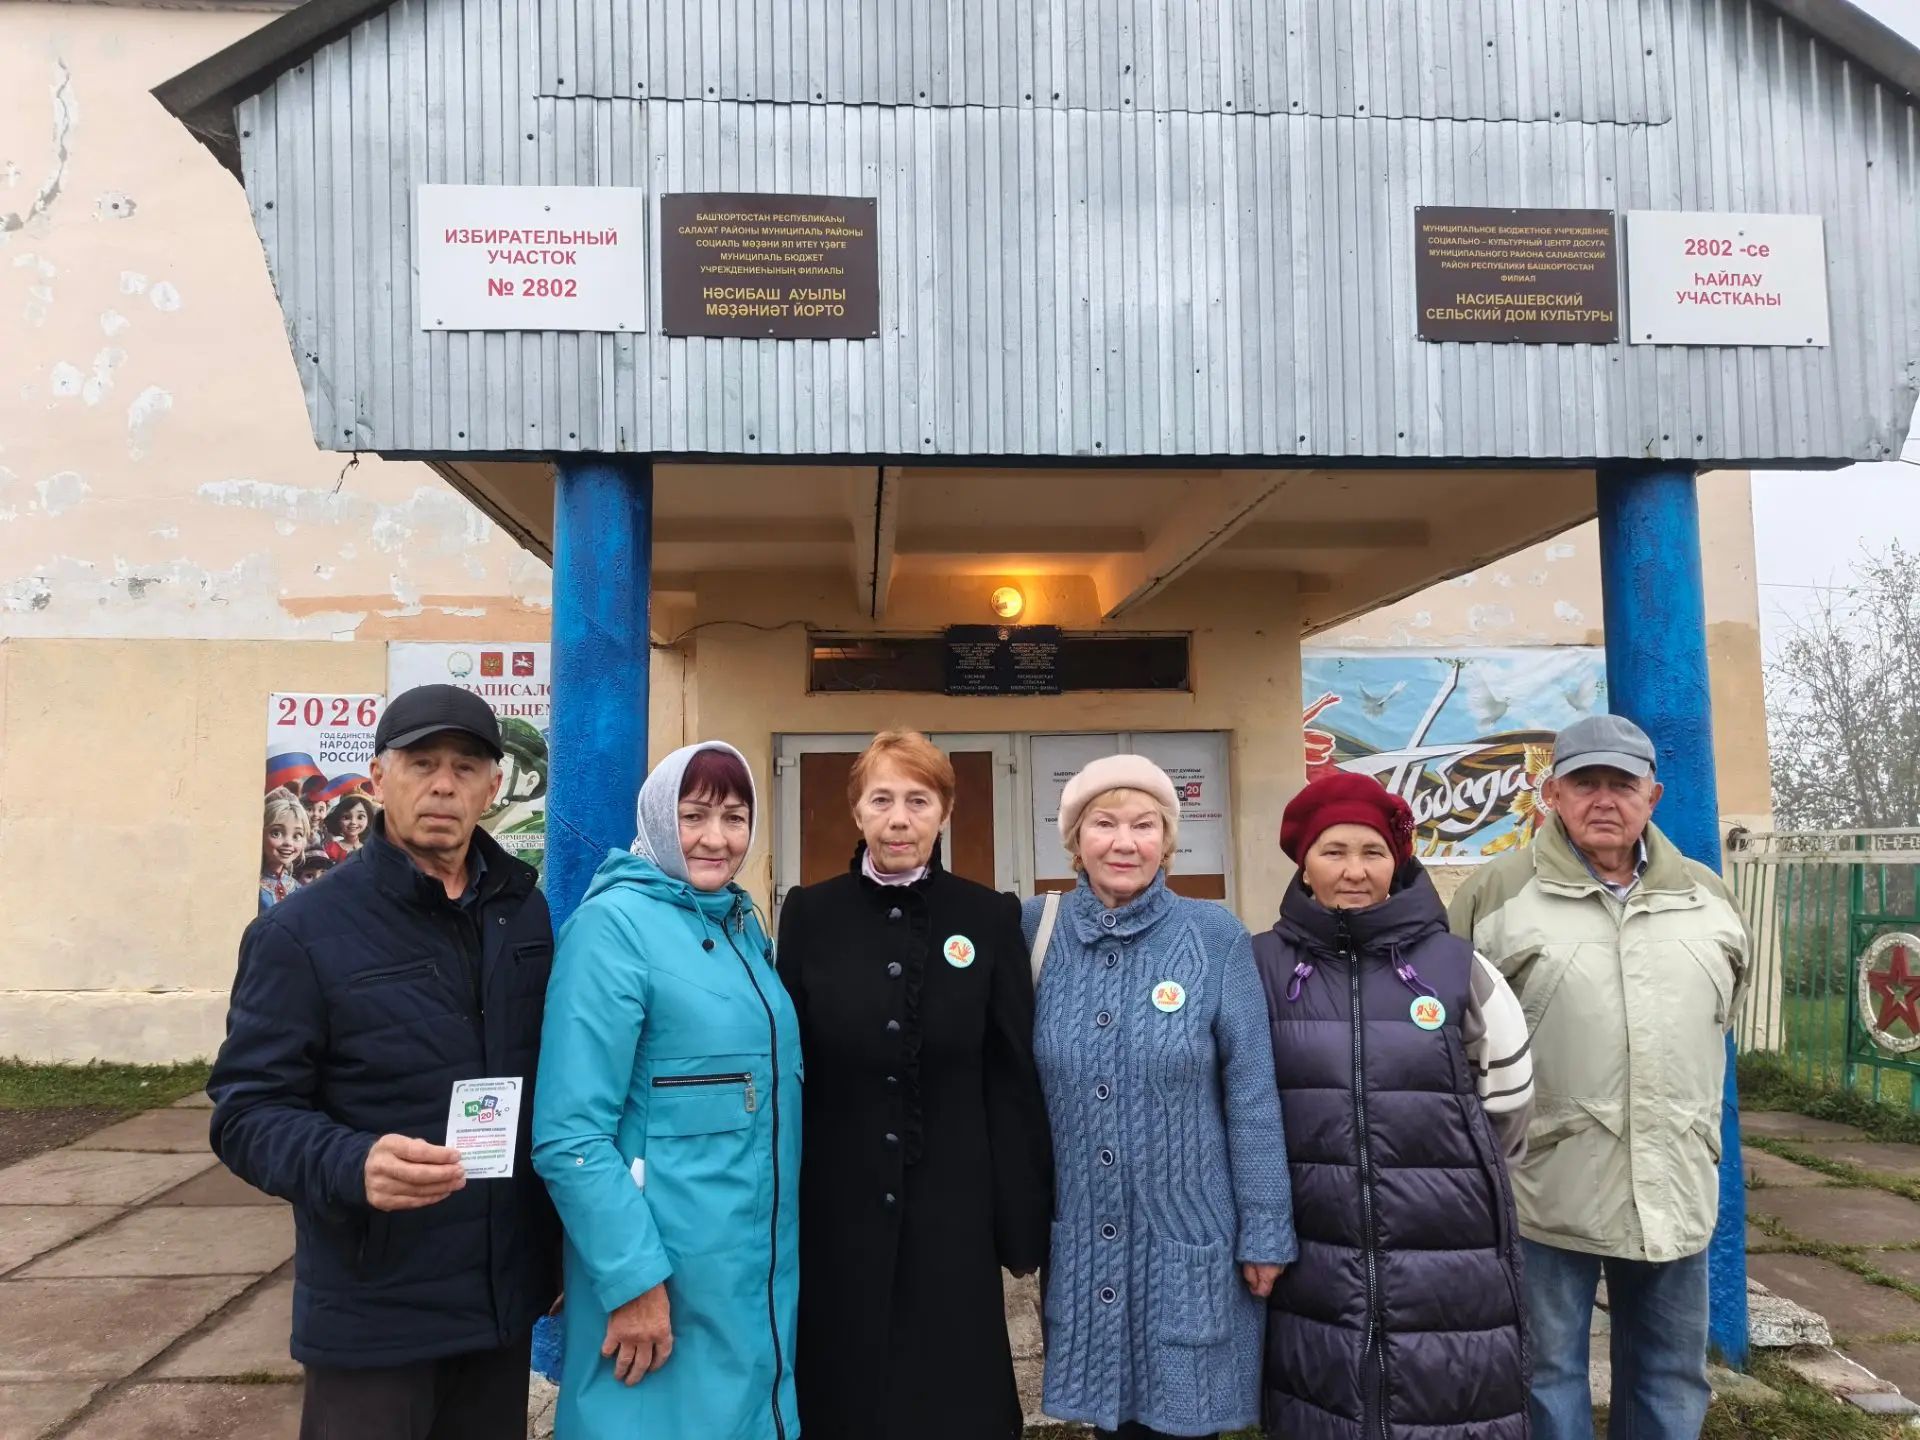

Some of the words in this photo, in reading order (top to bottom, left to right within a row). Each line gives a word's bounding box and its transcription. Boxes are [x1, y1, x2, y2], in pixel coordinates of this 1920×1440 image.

[721, 226, 759, 234] РАЙОНЫ
[762, 228, 822, 236] МУНИЦИПАЛЬ
[1423, 225, 1496, 234] МУНИЦИПАЛЬНОЕ
[445, 228, 617, 245] ИЗБИРАТЕЛЬНЫЙ
[696, 240, 739, 248] СОЦИАЛЬ
[1684, 239, 1732, 256] 2802
[1740, 244, 1769, 257] -се
[488, 250, 576, 264] УЧАСТОК
[720, 253, 782, 261] МУНИЦИПАЛЬ
[785, 254, 823, 262] БЮДЖЕТ
[1429, 250, 1508, 258] МУНИЦИПАЛЬНОГО
[488, 278, 514, 296] №
[523, 279, 577, 297] 2802
[704, 288, 780, 300] НӘСИБАШ
[789, 288, 845, 300] АУЫЛЫ
[1457, 292, 1582, 305] НАСИБАШЕВСКИЙ
[706, 304, 789, 318] МӘҘӘНИӘТ
[794, 301, 844, 316] ЙОРТО
[1426, 308, 1500, 320] СЕЛЬСКИЙ
[1505, 310, 1536, 322] ДОМ
[1541, 310, 1612, 322] КУЛЬТУРЫ
[277, 698, 376, 727] 2026
[320, 741, 375, 750] НАРОДОВ
[320, 752, 374, 762] РОССИИ
[1187, 786, 1199, 794] 20
[468, 1105, 478, 1113] 10
